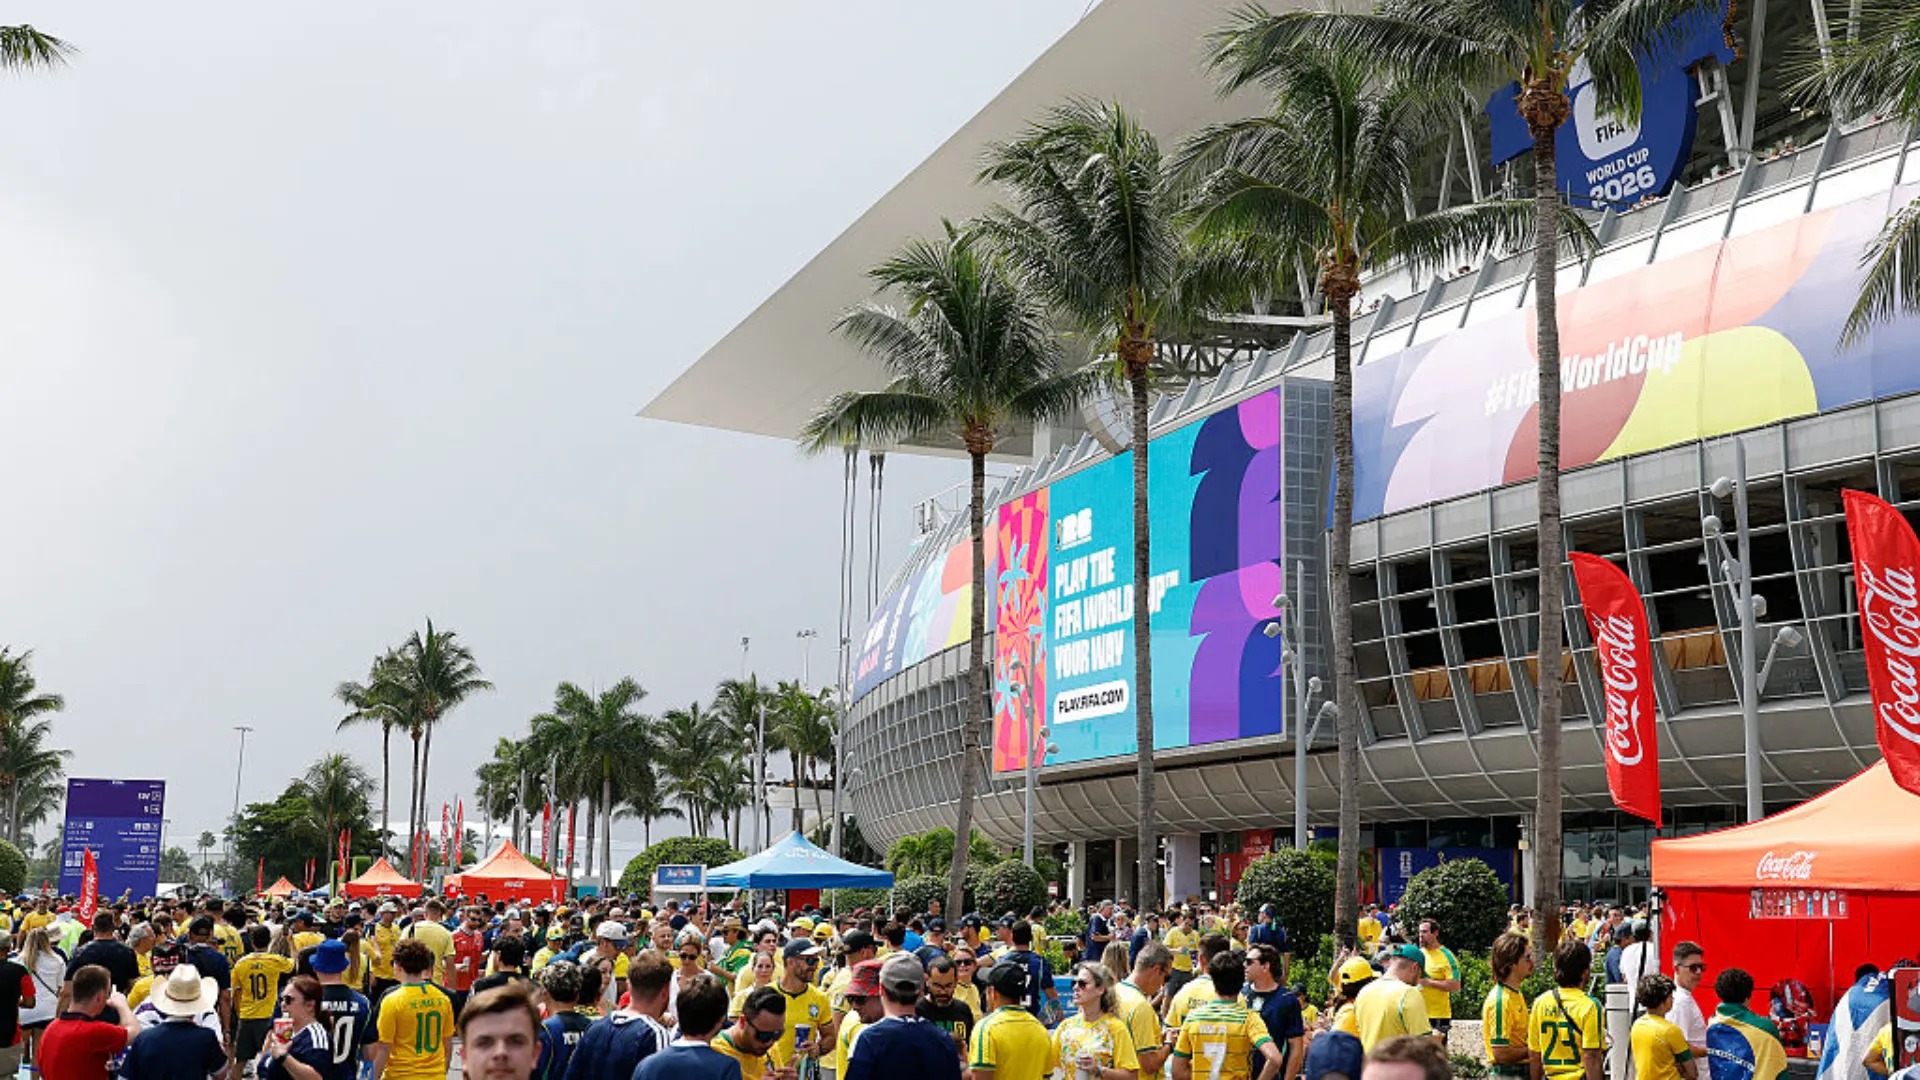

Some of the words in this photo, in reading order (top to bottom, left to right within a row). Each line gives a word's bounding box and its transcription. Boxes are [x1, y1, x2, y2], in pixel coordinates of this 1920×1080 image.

[1586, 158, 1627, 184] WORLD
[1626, 147, 1650, 168] CUP
[1590, 165, 1656, 209] 2026
[1055, 555, 1089, 600] PLAY
[1089, 546, 1116, 588] THE
[1055, 599, 1083, 640] FIFA
[1083, 583, 1134, 631] WORLD
[1054, 639, 1090, 681] YOUR
[1090, 629, 1125, 672] WAY
[1058, 687, 1124, 714] PLAY.FIFA.COM
[1591, 610, 1644, 767] Coca-Cola
[1756, 850, 1817, 880] Coca-Cola
[249, 972, 268, 1000] 10
[416, 1010, 442, 1055] 10
[1541, 1021, 1582, 1066] 23
[1202, 1042, 1228, 1080] 7
